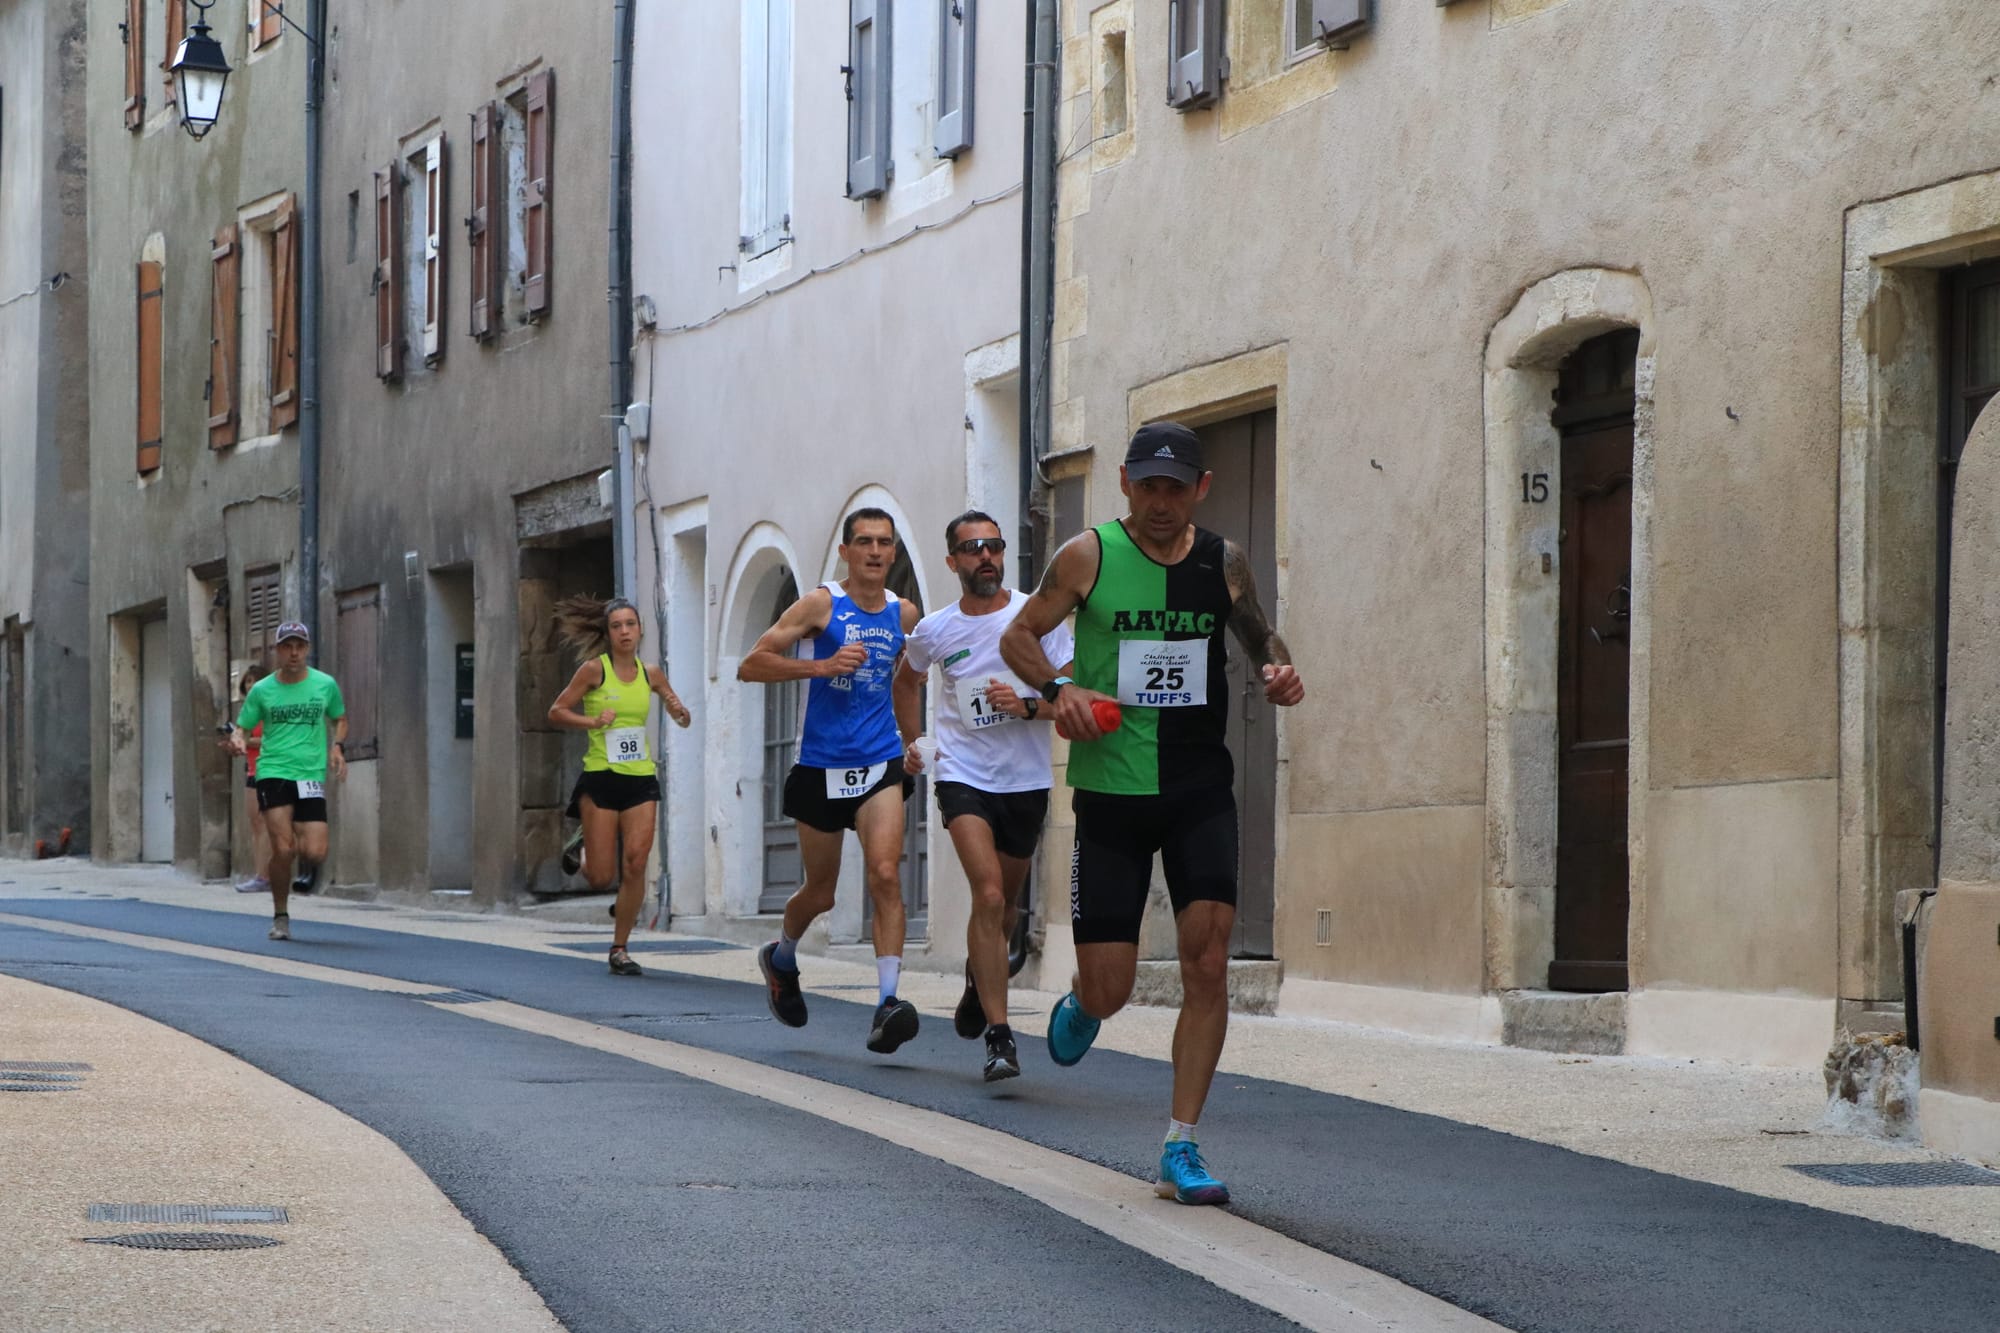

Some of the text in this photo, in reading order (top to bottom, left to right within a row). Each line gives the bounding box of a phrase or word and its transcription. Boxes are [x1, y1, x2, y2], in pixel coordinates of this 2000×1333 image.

[1521, 472, 1549, 503] 15
[1112, 610, 1216, 634] AATAC
[1145, 667, 1184, 690] 25
[1135, 692, 1192, 704] TUFF'S
[620, 740, 638, 753] 98
[845, 767, 870, 786] 67
